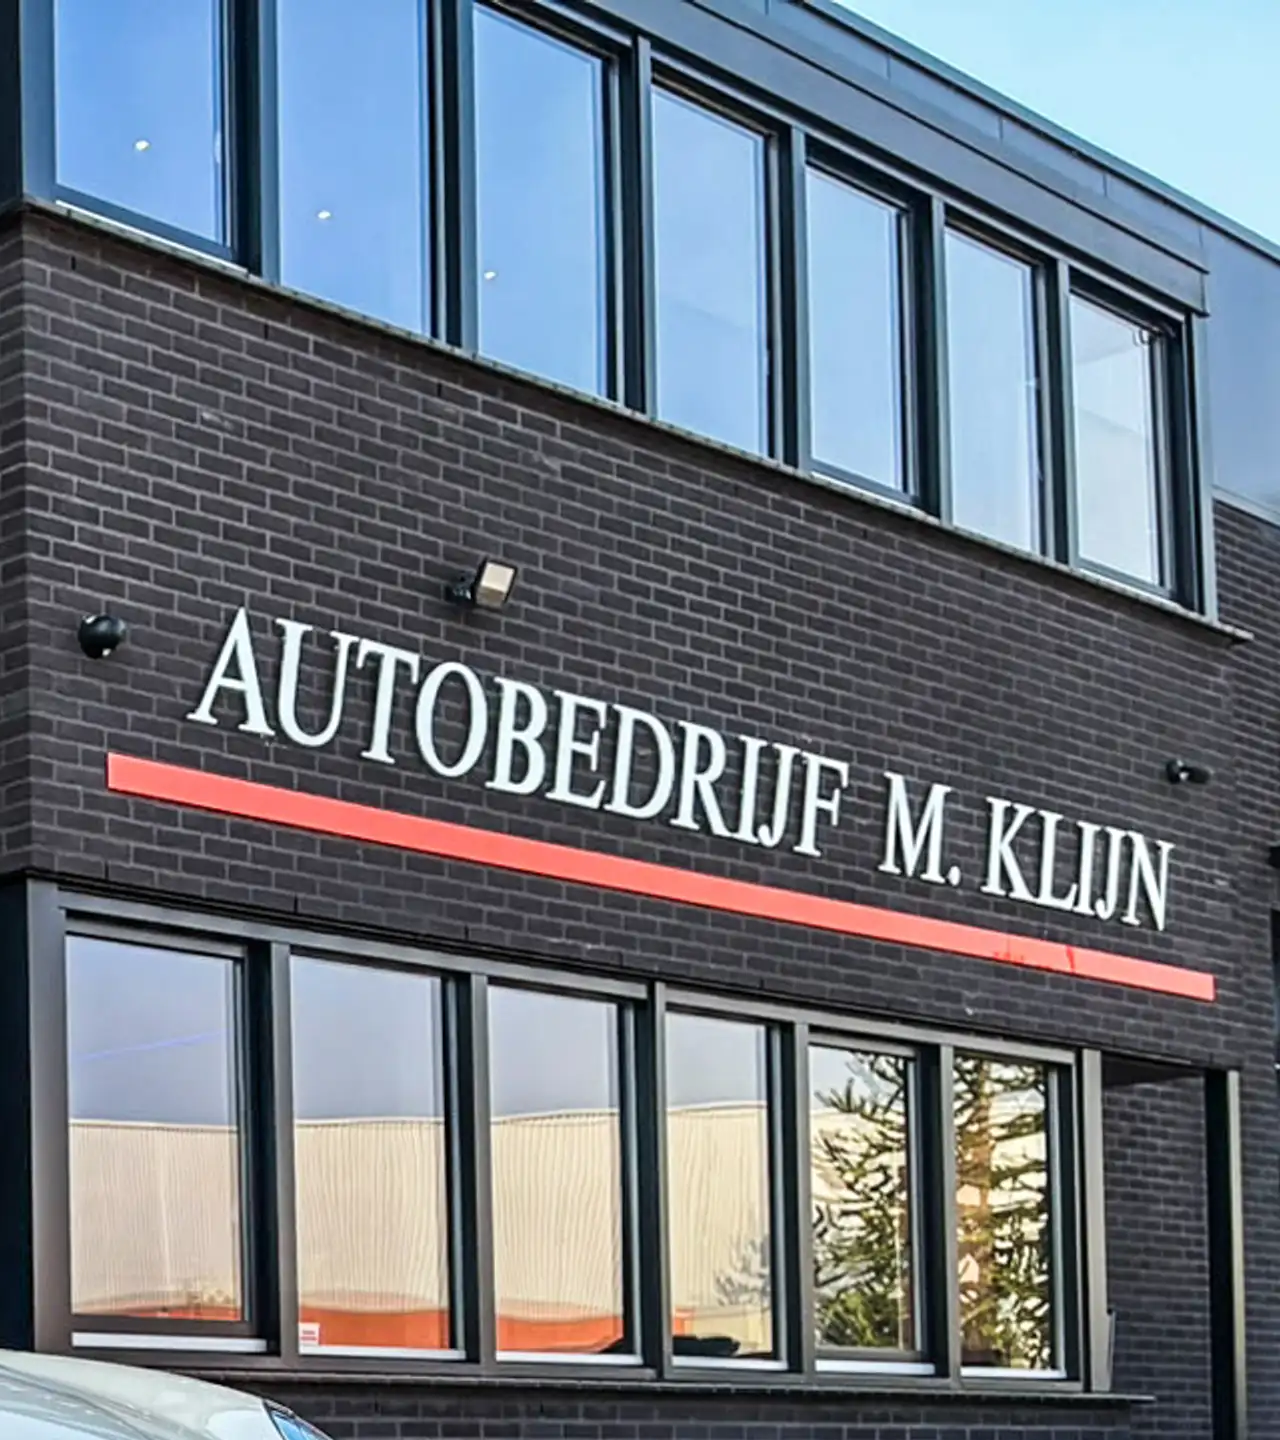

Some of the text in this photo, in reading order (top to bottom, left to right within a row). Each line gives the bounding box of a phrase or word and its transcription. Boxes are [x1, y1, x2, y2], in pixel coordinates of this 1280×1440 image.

[186, 606, 1176, 932] AUTOBEDRIJF M. KLIJN
